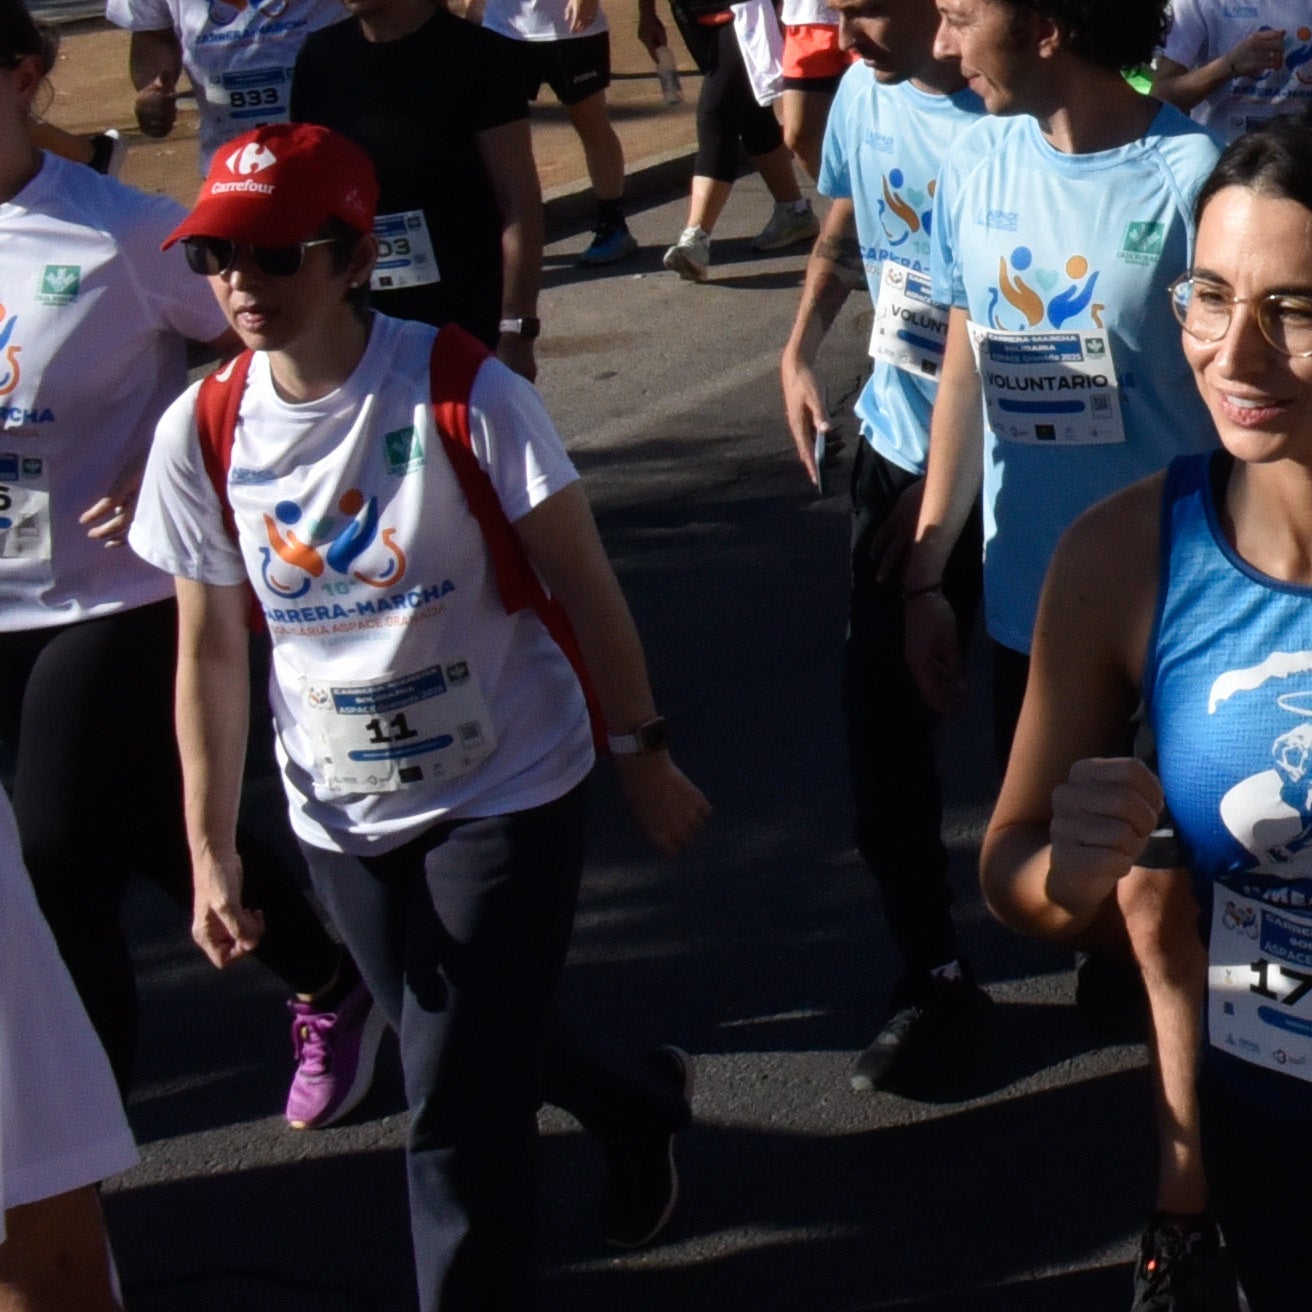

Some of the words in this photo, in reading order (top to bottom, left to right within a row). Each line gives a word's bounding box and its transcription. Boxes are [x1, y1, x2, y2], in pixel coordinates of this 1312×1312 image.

[229, 88, 279, 108] 833
[211, 179, 275, 195] Carrefour
[985, 374, 1109, 392] VOLUNTARIO
[366, 712, 418, 744] 11
